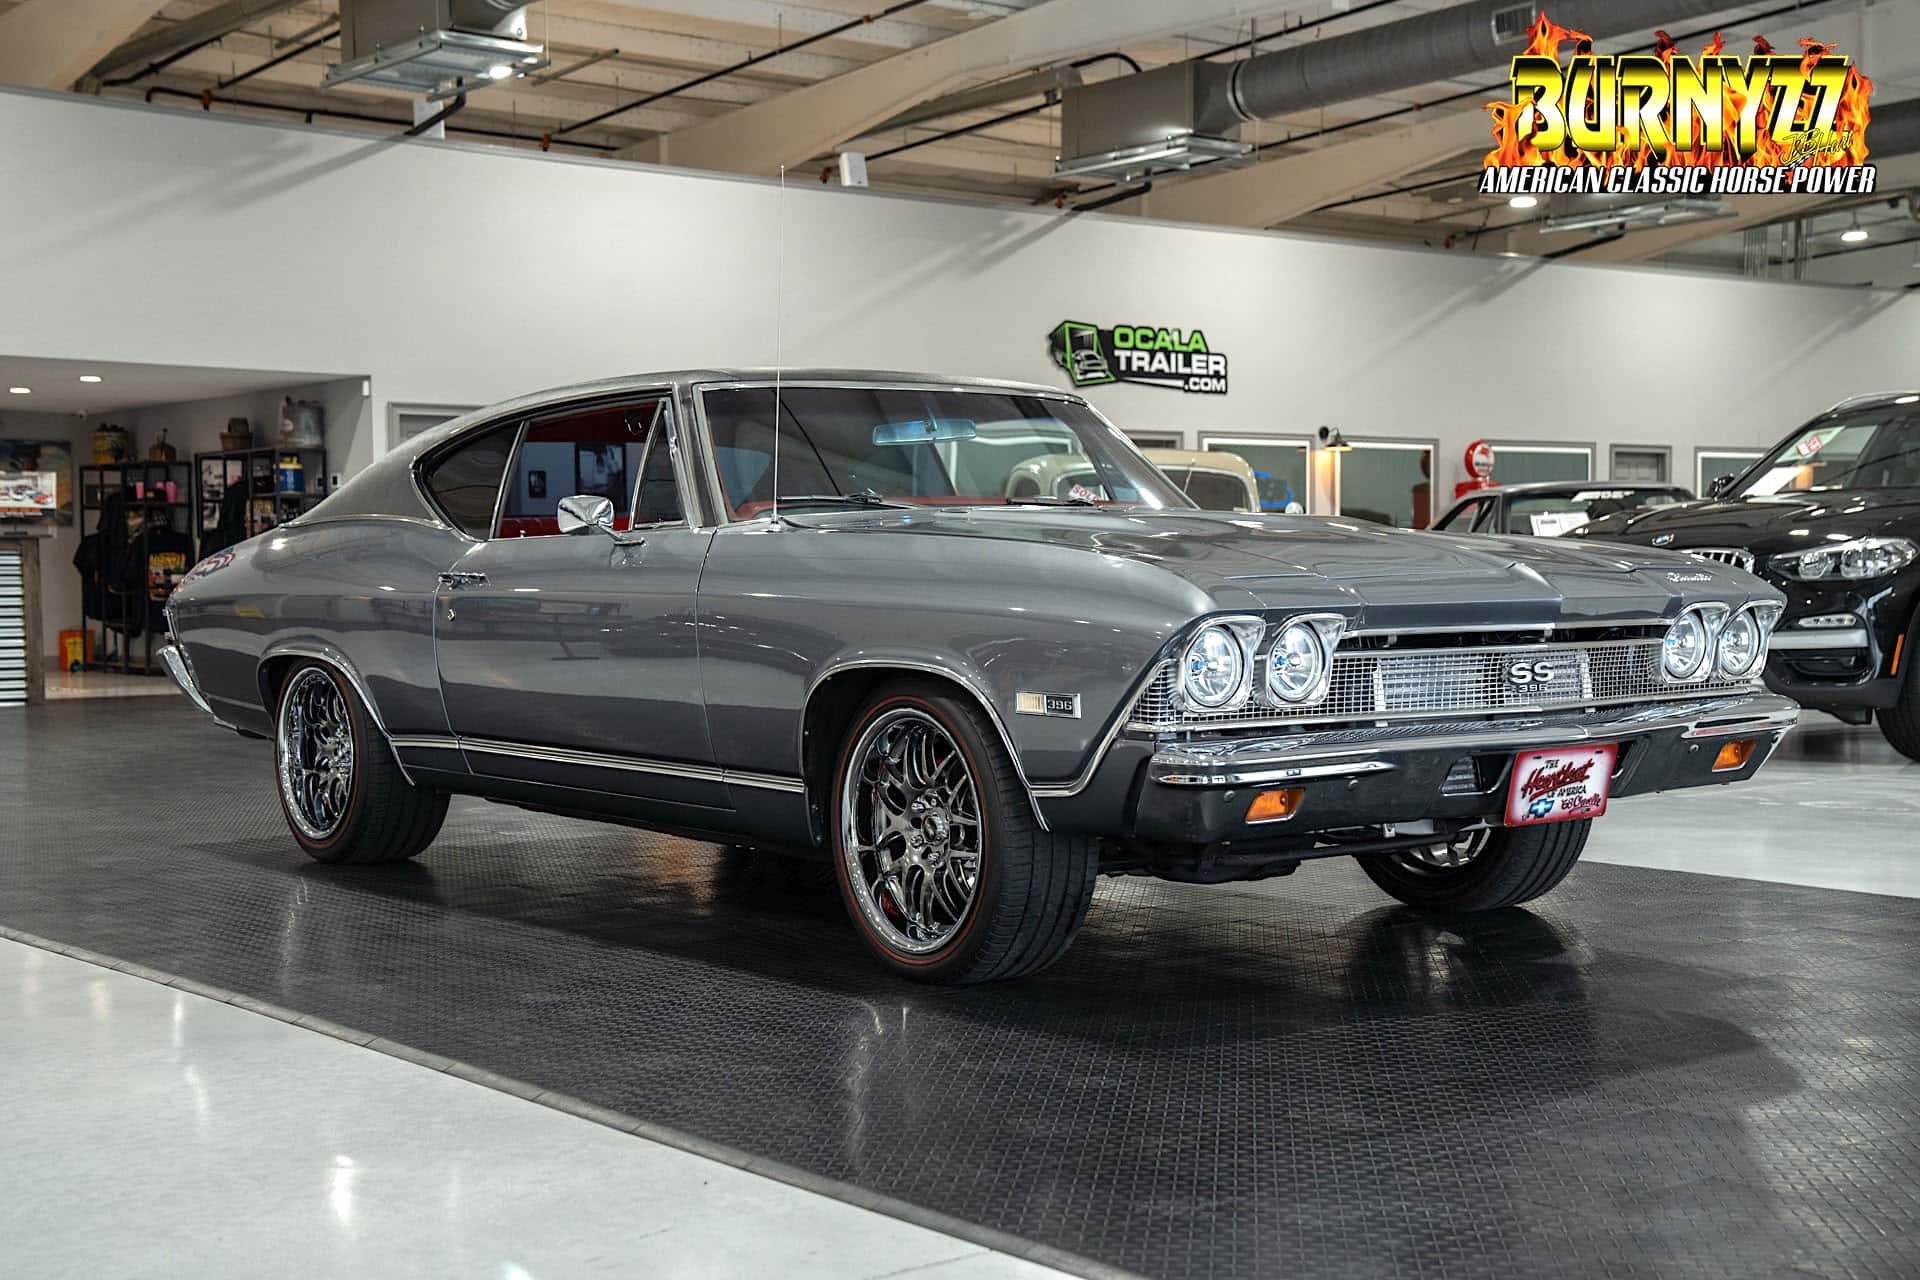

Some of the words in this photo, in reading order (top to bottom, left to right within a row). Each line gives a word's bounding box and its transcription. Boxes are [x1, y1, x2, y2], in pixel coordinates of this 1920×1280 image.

[1113, 326, 1208, 352] OCALA
[1113, 351, 1226, 375] TRAILER
[1184, 377, 1226, 392] .COM
[1510, 662, 1555, 684] SS
[1047, 699, 1073, 711] 396
[1557, 784, 1588, 798] AMERICA
